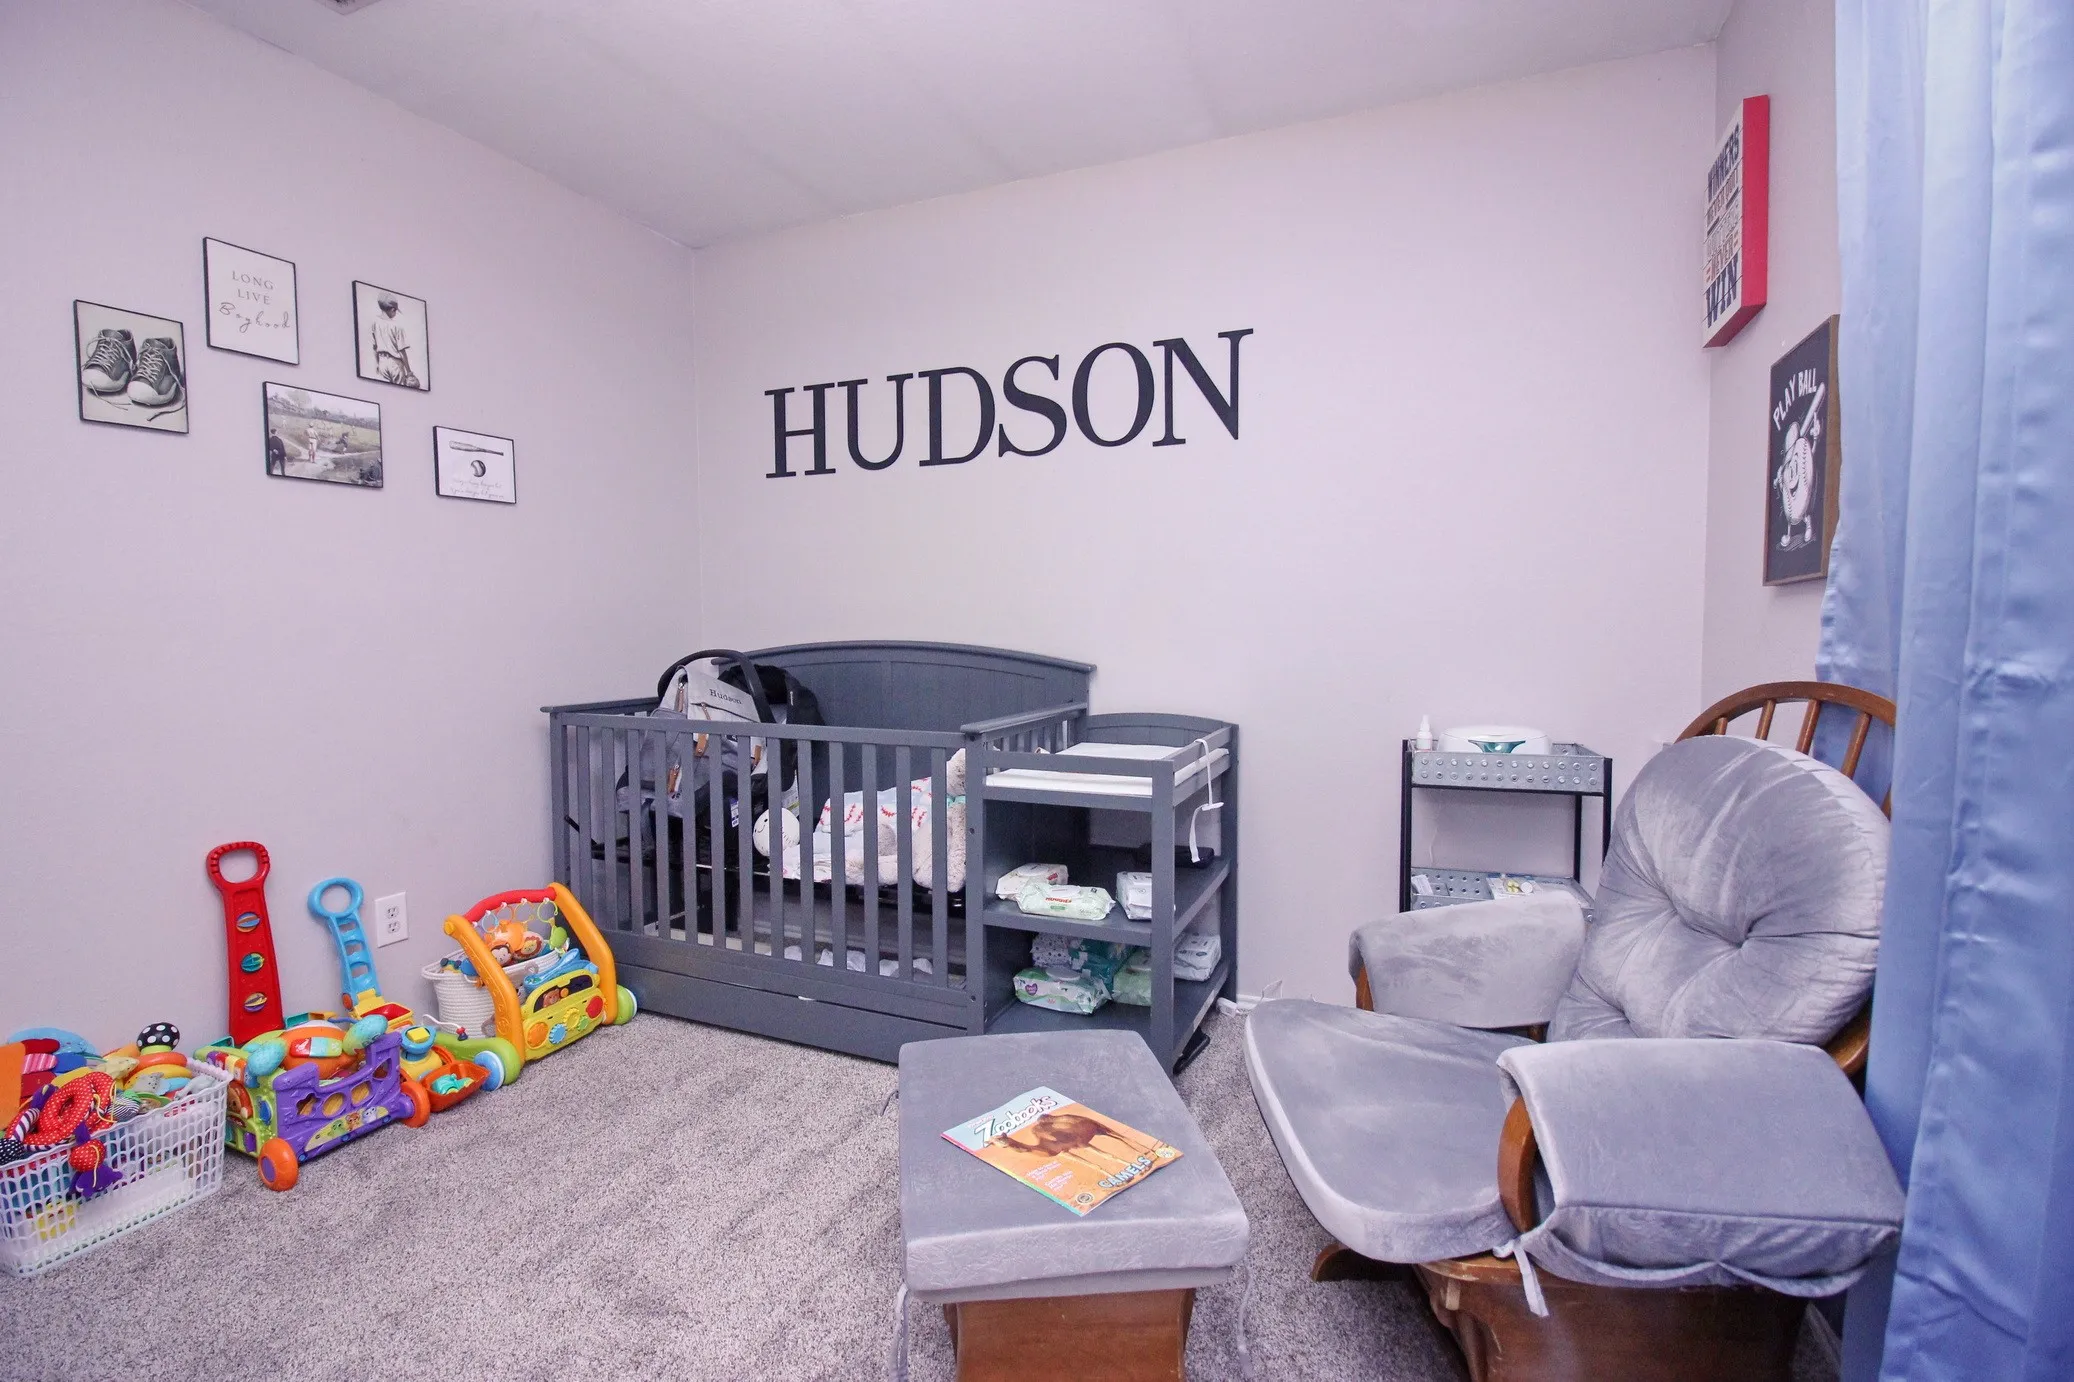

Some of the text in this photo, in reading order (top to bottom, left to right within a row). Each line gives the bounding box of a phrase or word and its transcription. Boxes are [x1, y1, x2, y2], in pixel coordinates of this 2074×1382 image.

[232, 270, 274, 290] LONG
[237, 288, 271, 305] LIVE
[1705, 251, 1738, 328] WIN
[219, 301, 291, 334] Boyhood
[764, 328, 1254, 479] HUDSON
[1773, 367, 1817, 431] PLAY BALL
[709, 689, 742, 704] Hudson
[974, 1095, 1058, 1148] Zoobooks
[1098, 1156, 1153, 1188] CAMELS
